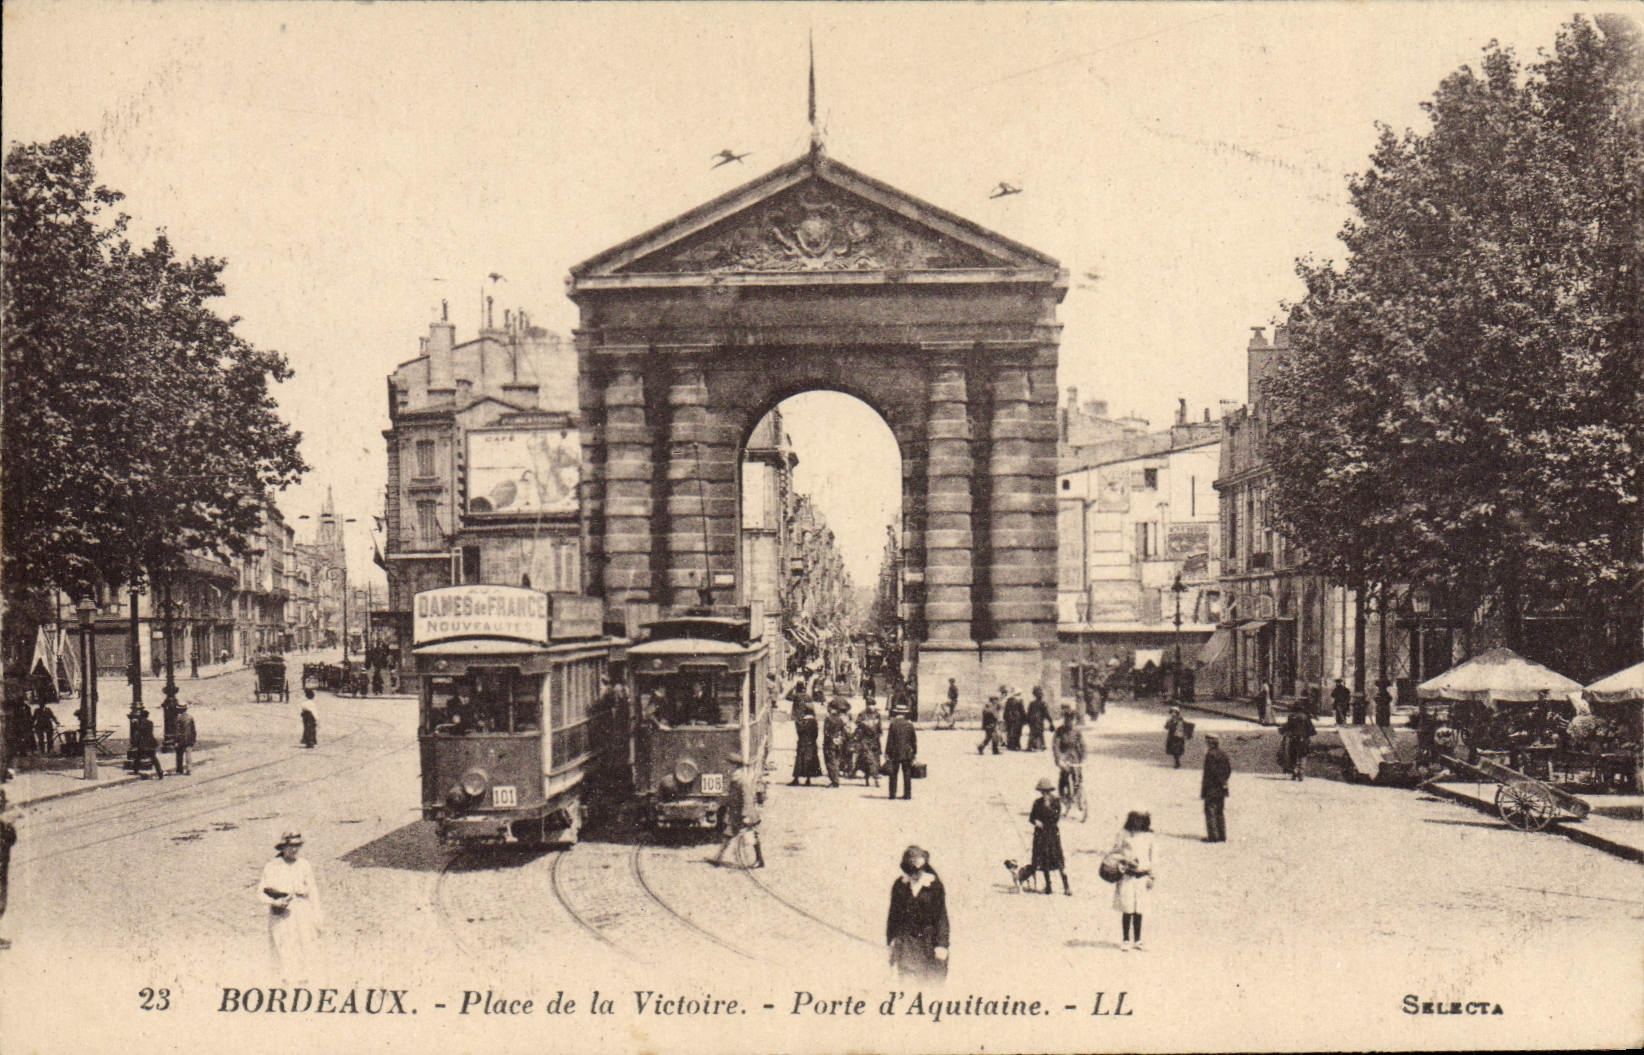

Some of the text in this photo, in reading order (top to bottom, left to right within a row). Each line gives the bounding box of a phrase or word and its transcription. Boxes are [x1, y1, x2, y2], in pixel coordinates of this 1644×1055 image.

[418, 595, 473, 618] DAMES
[487, 595, 546, 618] FRANCE
[495, 789, 514, 804] 101
